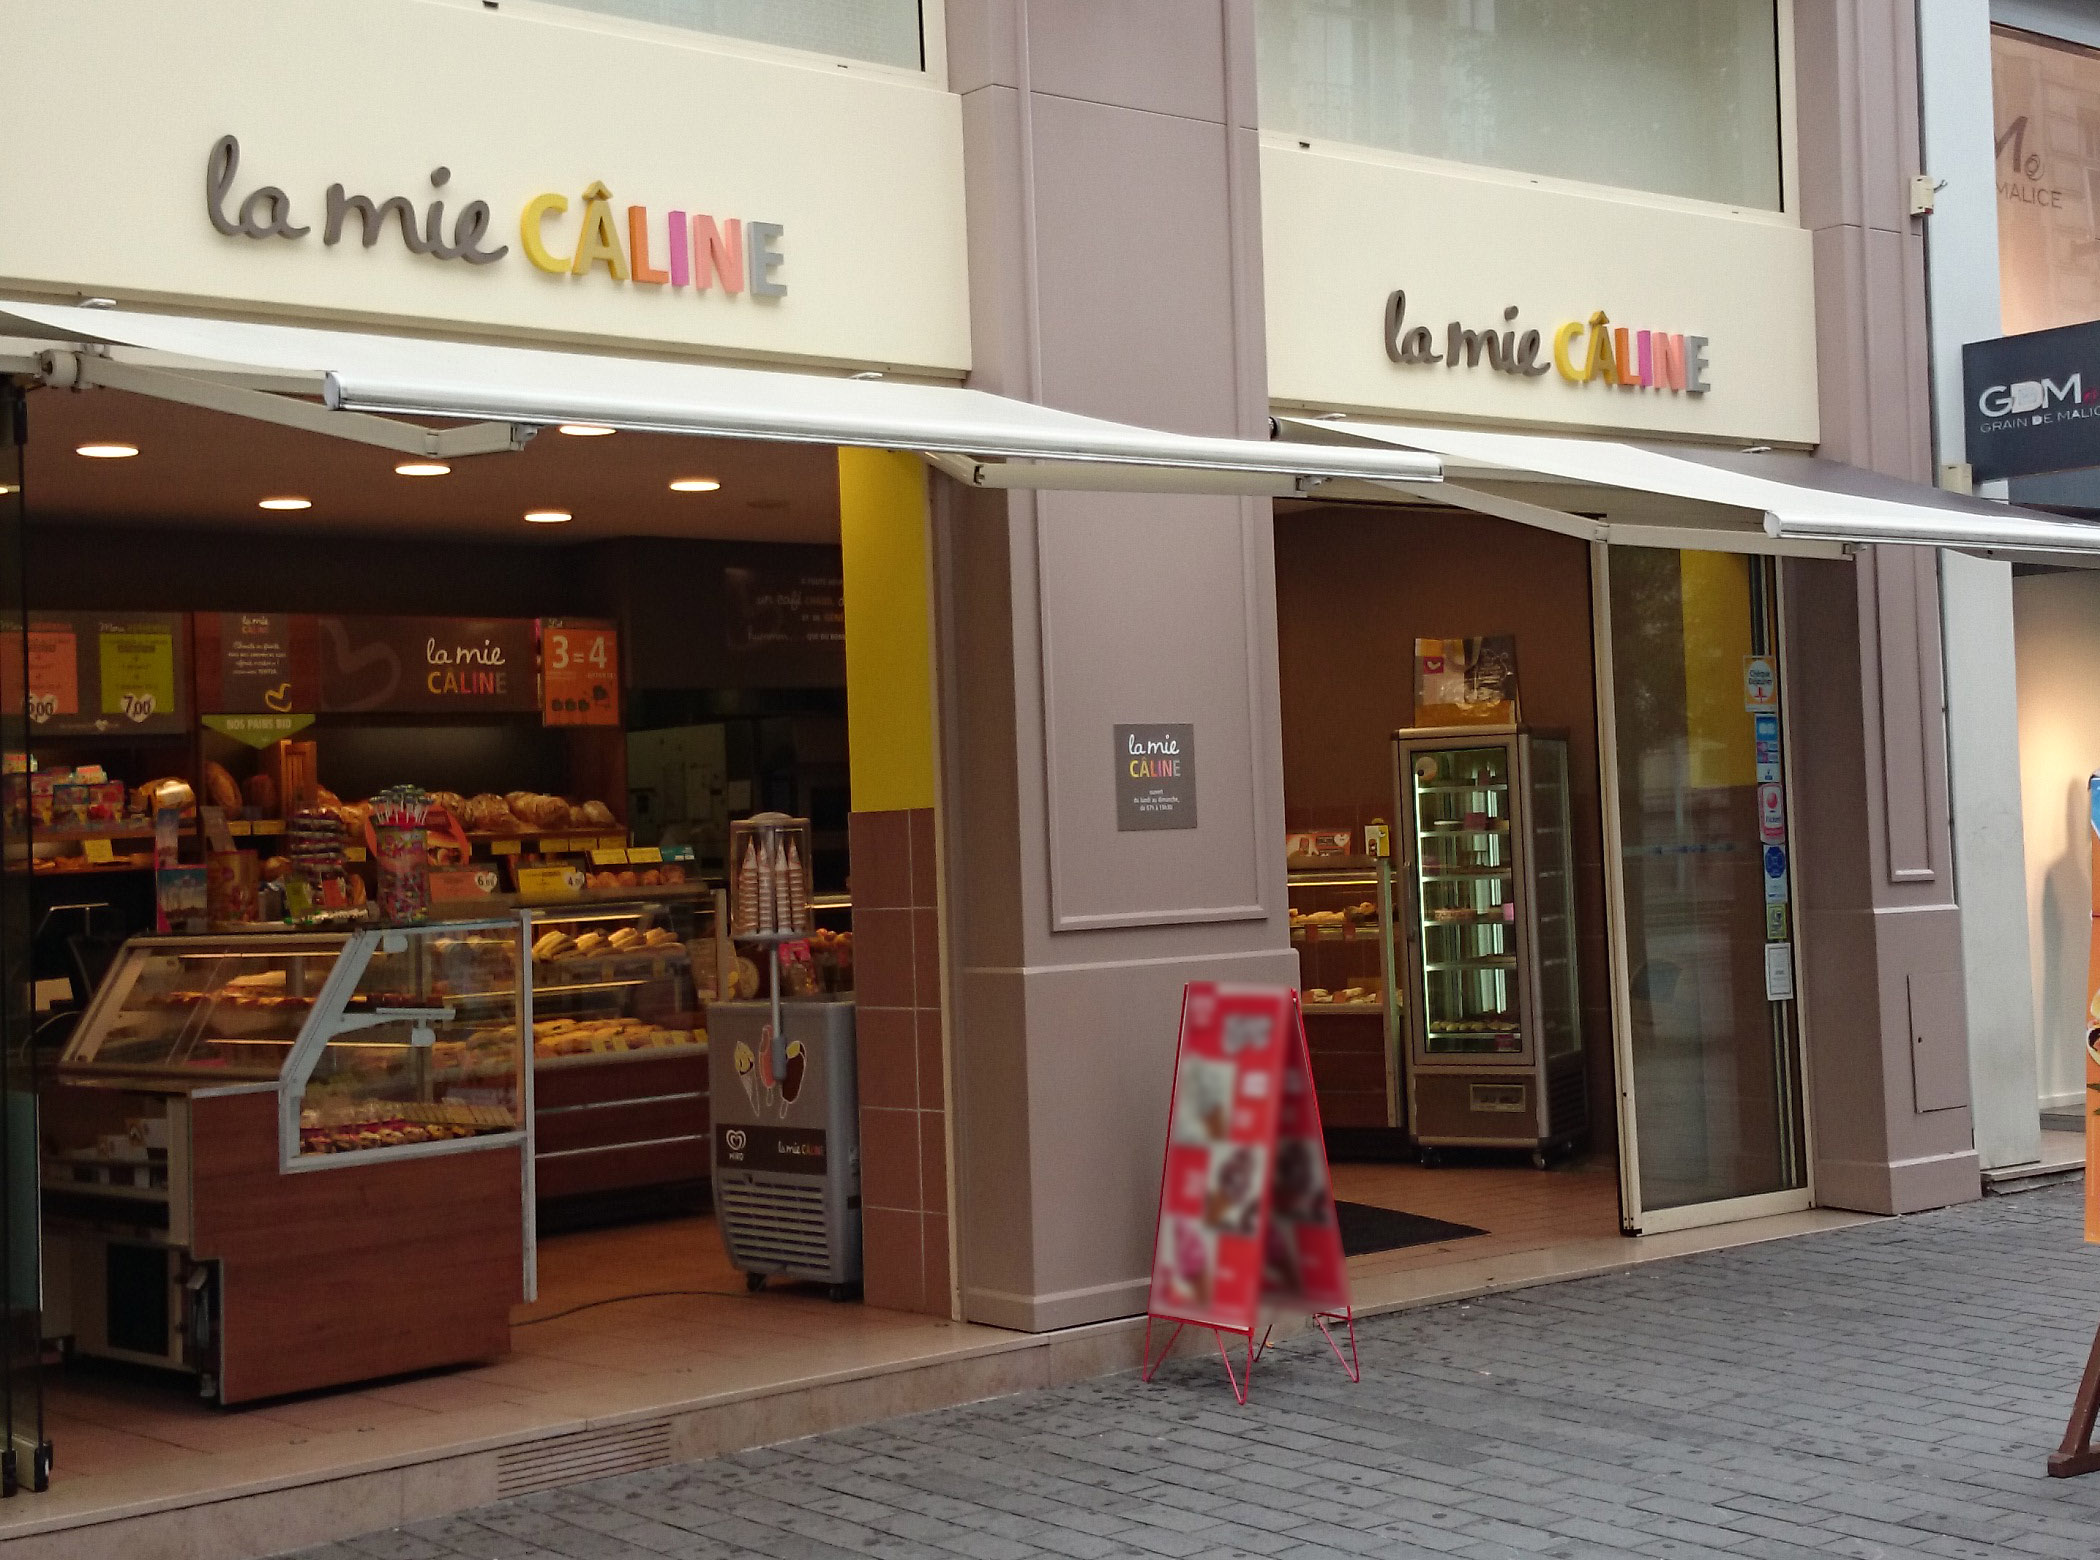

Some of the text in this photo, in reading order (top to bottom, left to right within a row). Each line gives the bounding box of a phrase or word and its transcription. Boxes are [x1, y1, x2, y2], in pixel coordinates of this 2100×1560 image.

[1996, 182, 2063, 210] MALICE
[206, 134, 788, 299] la mie CÂLINE
[1385, 289, 1711, 394] la mie CÂLINE
[1979, 372, 2082, 418] GDM
[1980, 417, 2028, 434] GRAIN
[2031, 413, 2054, 426] DE
[426, 637, 506, 665] la mie
[1128, 733, 1180, 755] la mie
[1129, 755, 1182, 778] CÂLINE
